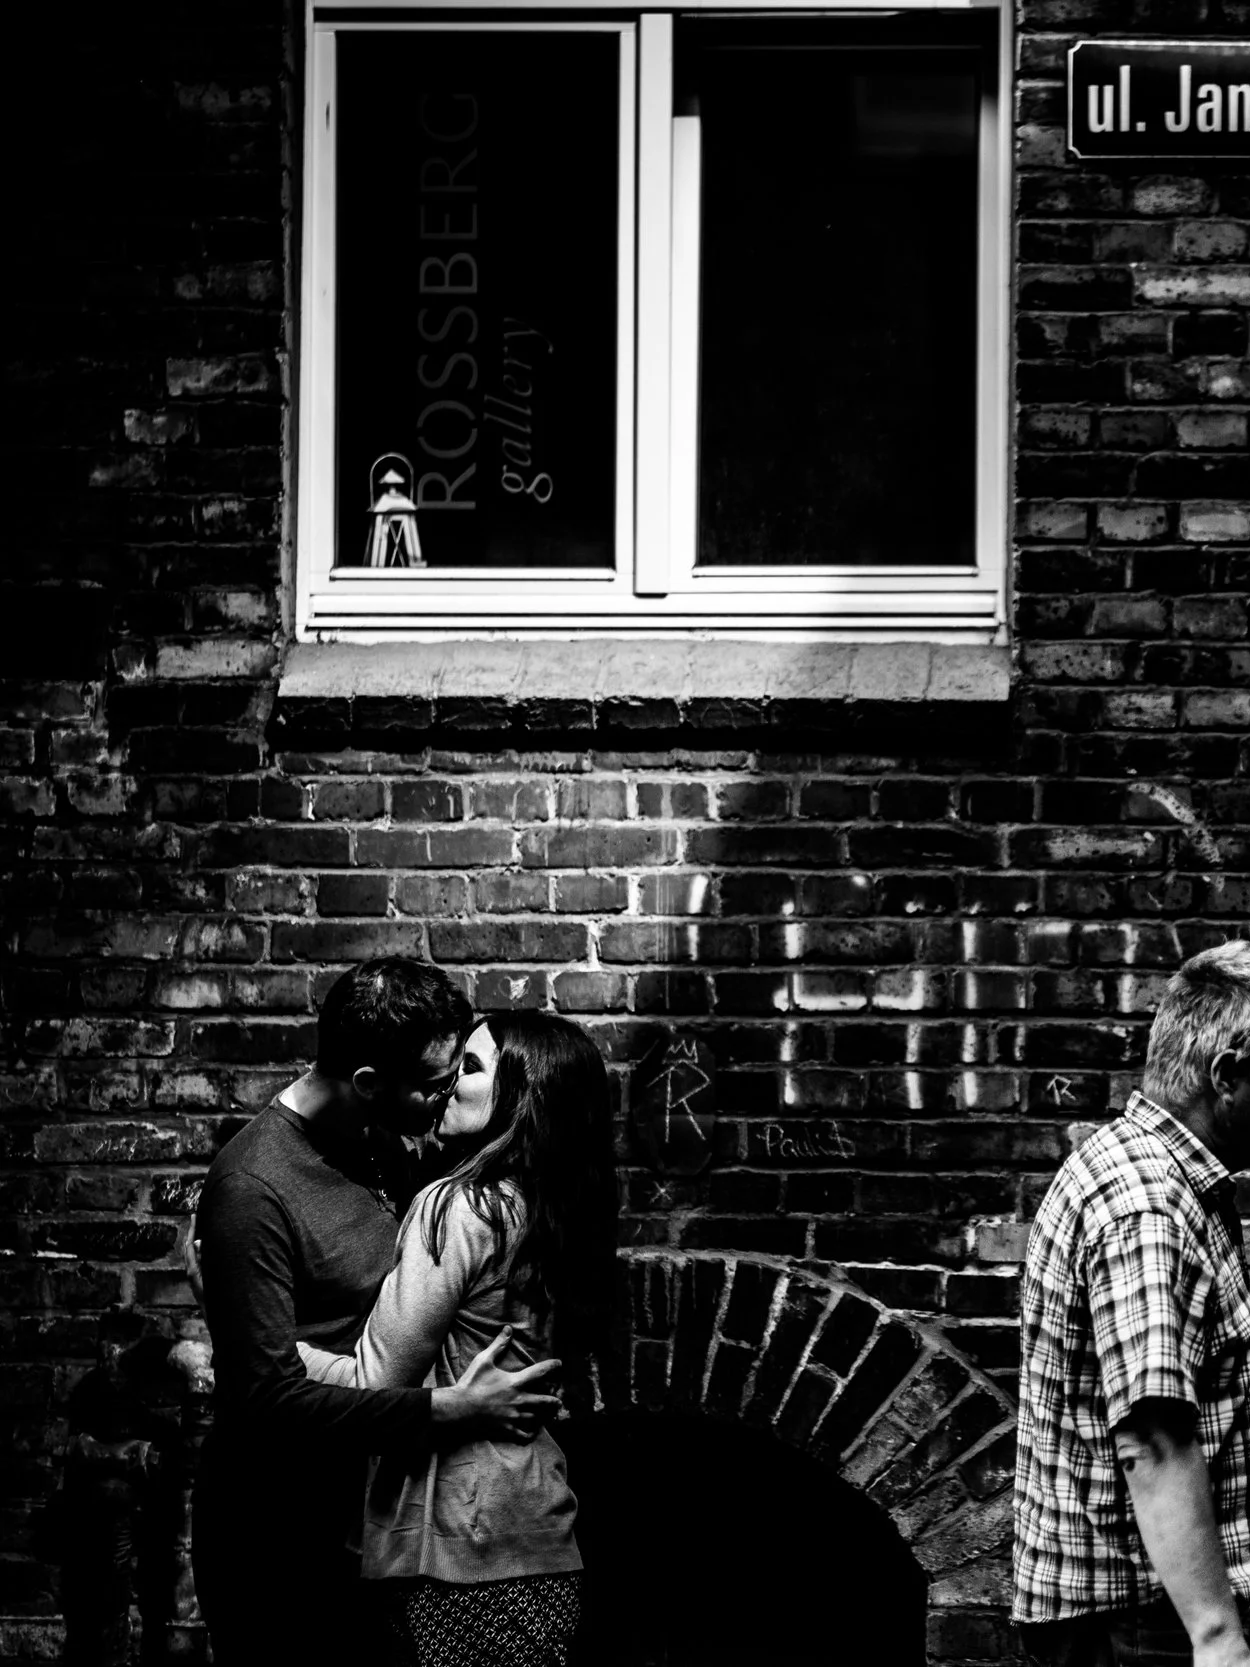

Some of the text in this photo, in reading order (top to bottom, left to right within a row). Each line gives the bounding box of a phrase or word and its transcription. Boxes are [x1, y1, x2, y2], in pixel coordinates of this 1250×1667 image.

[1087, 64, 1147, 133] ul.
[416, 91, 479, 511] ROSSBERG
[483, 316, 556, 504] gallery
